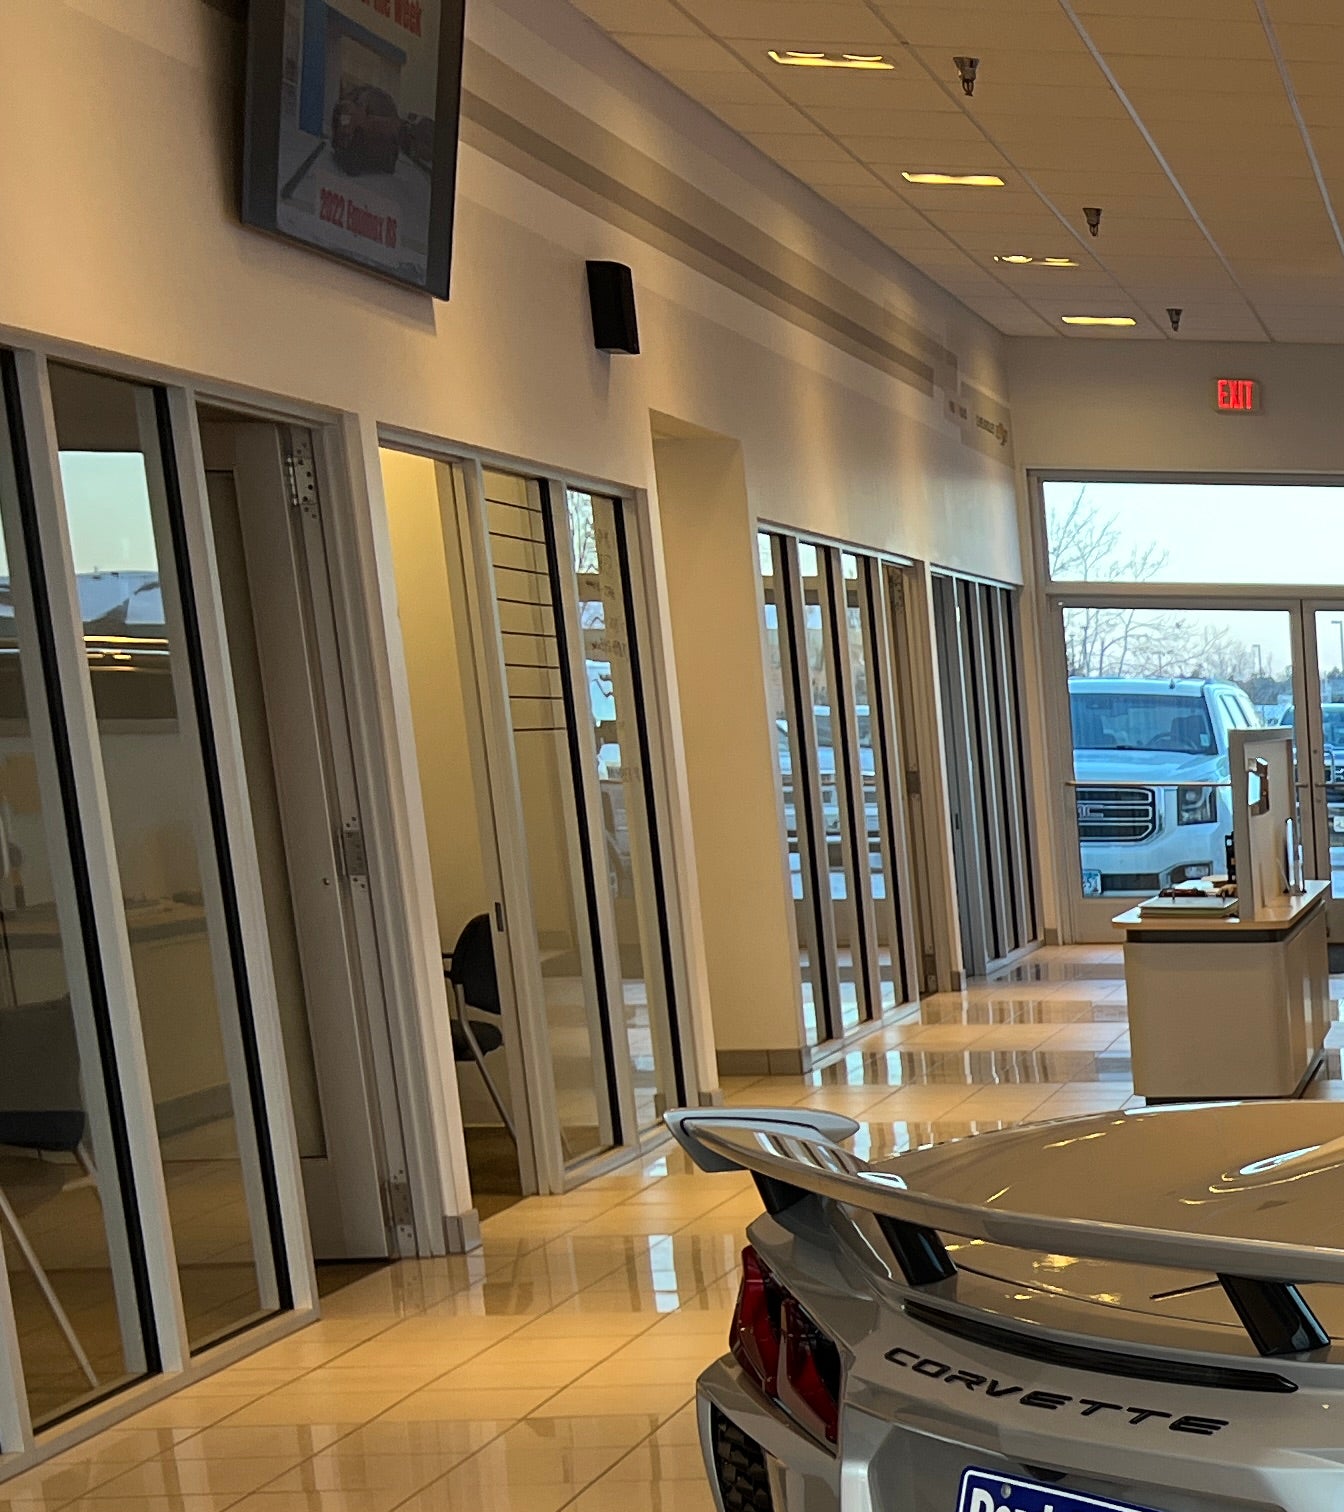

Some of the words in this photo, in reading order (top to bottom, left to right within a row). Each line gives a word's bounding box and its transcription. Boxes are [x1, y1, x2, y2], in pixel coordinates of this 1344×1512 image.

[320, 187, 345, 228] 2022
[1217, 379, 1254, 409] EXIT
[884, 1347, 1229, 1435] CORVETTE
